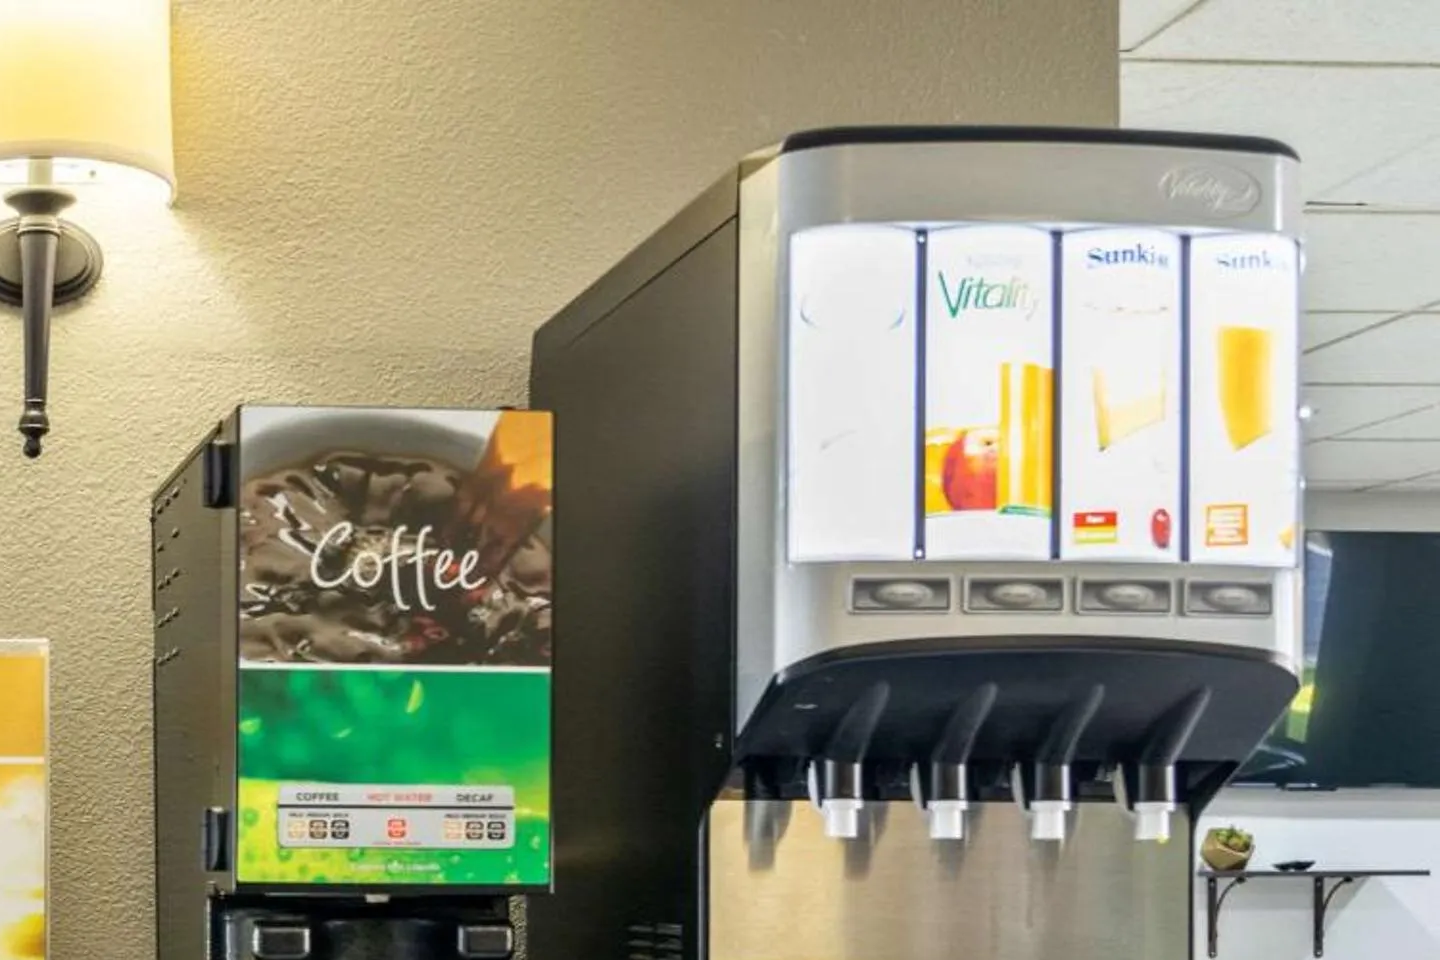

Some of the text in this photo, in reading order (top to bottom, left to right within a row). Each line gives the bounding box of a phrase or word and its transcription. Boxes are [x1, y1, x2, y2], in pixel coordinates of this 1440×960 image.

[1087, 242, 1169, 269] Sunki
[310, 521, 488, 611] Coffee
[295, 792, 340, 802] COFFEE
[455, 793, 495, 803] DECAF
